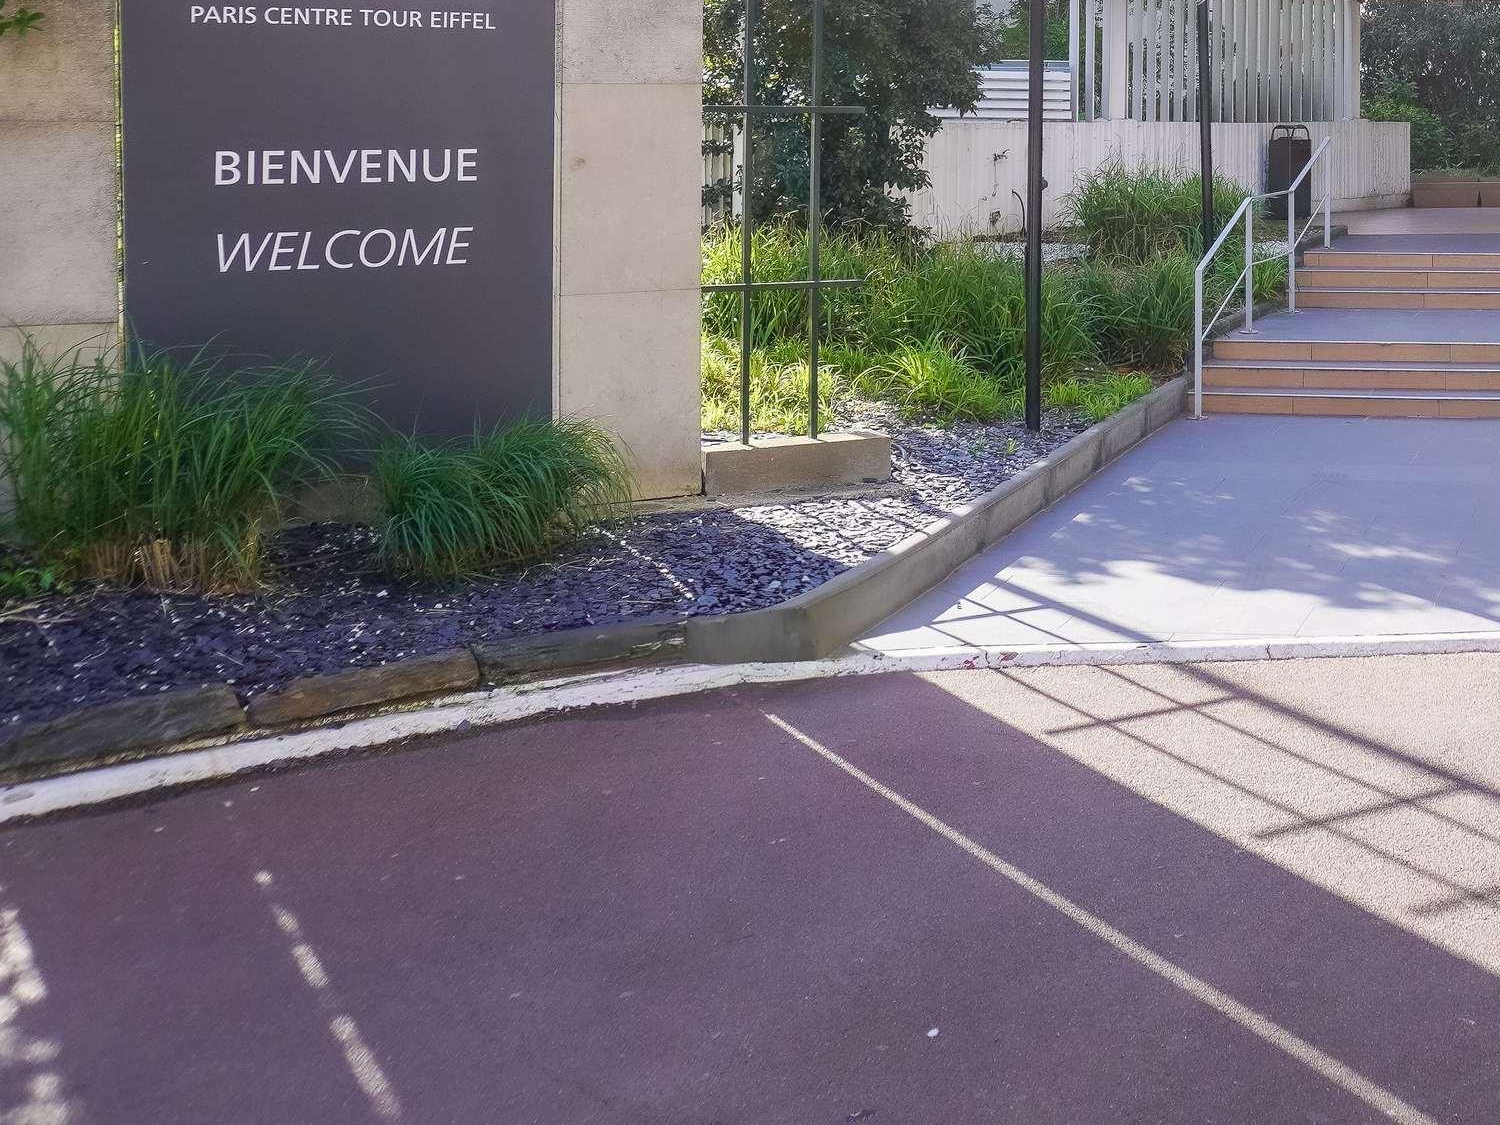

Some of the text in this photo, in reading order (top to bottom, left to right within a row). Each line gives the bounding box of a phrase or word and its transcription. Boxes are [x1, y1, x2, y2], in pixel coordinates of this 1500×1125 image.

[190, 5, 496, 30] PARIS CENTRE TOUR EIFFEL
[214, 148, 478, 186] BIENVENUE
[216, 226, 474, 273] WELCOME
